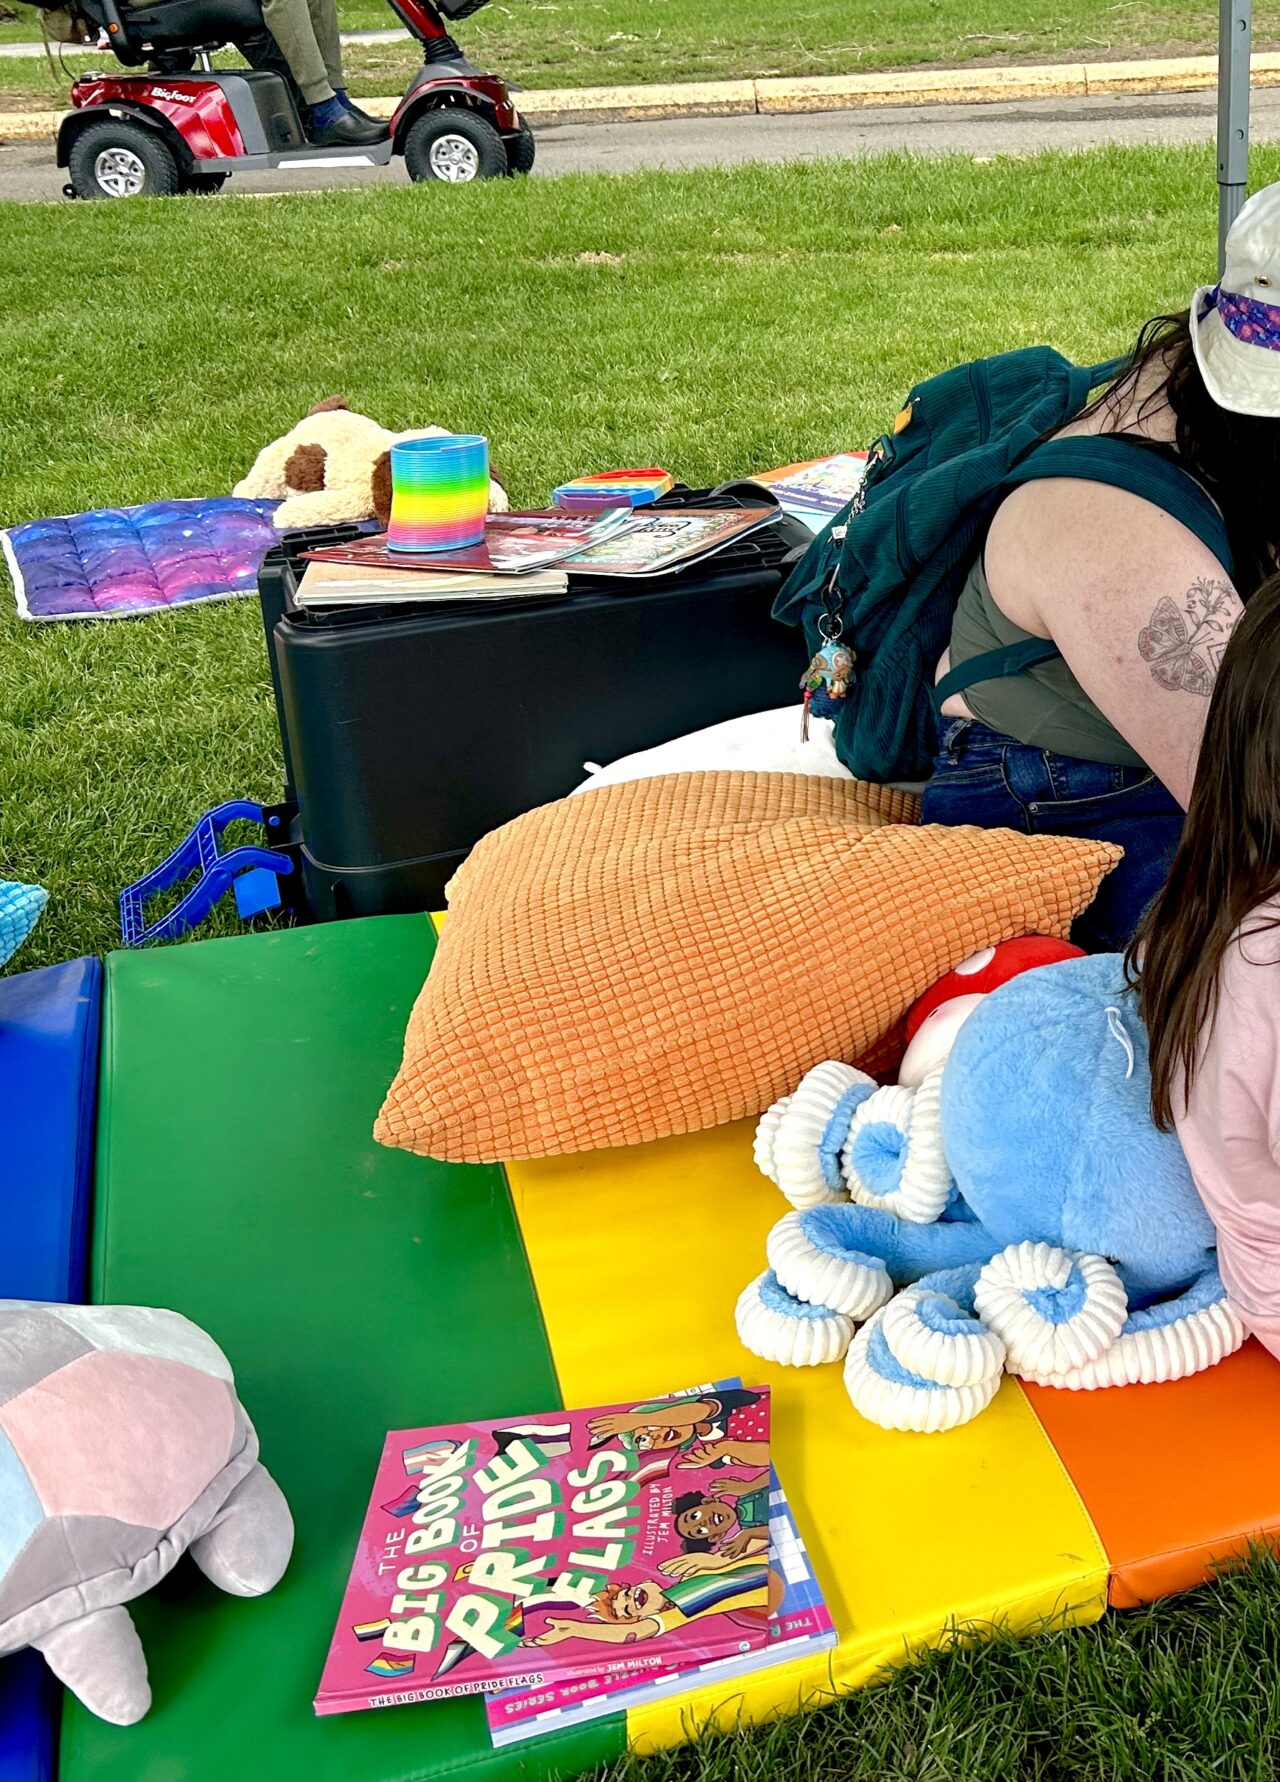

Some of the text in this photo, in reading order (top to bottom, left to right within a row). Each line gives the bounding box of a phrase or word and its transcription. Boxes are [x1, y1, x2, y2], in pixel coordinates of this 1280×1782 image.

[551, 1450, 629, 1607] FLAGS
[642, 1483, 661, 1556] ILLUSTRATED BY
[656, 1486, 674, 1543] JEM MILTON
[378, 1527, 407, 1576] THE
[382, 1438, 471, 1653] BIG BOOK
[444, 1439, 556, 1660] PRIDE
[460, 1523, 481, 1553] OF
[785, 1617, 813, 1632] THE
[607, 1661, 625, 1673] JEM
[627, 1656, 662, 1669] MILTON
[369, 1673, 543, 1706] THE BIG BOOK OF PRIDE FLAGS
[504, 1691, 555, 1714] SERIES
[560, 1679, 600, 1697] BOOK
